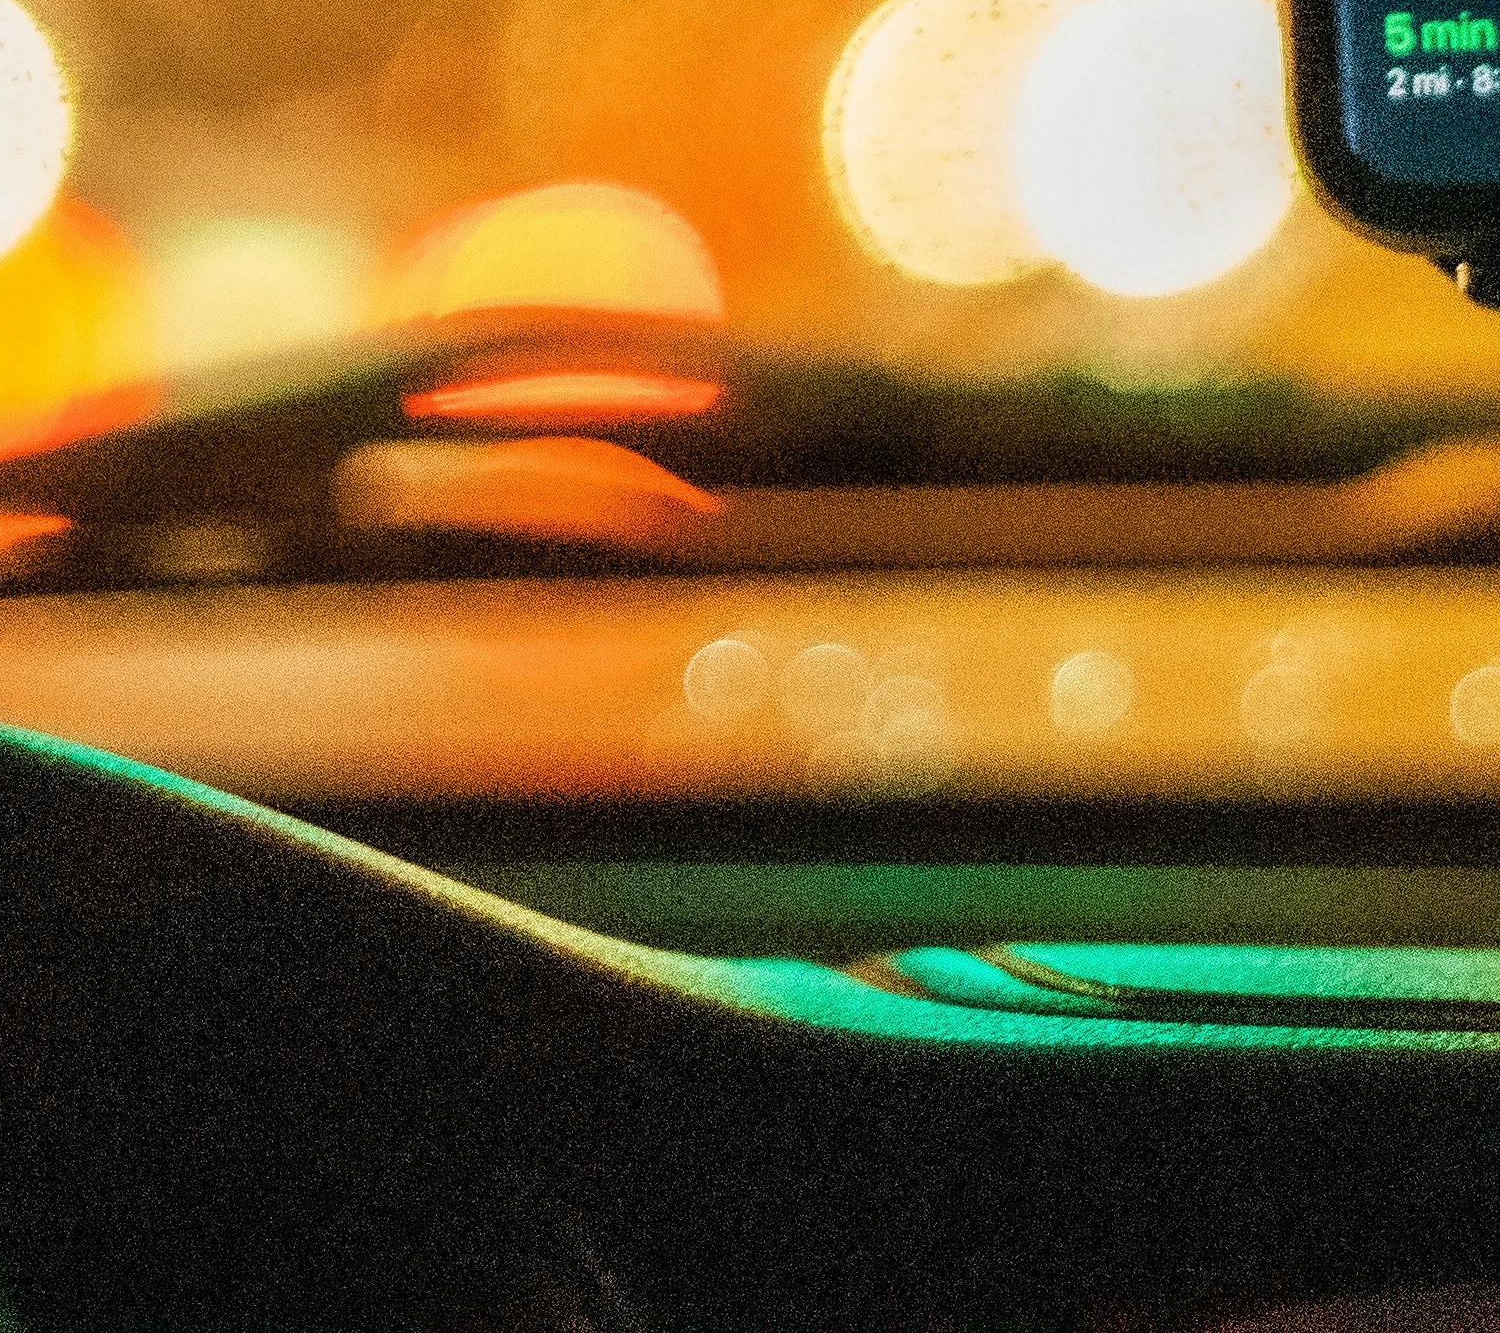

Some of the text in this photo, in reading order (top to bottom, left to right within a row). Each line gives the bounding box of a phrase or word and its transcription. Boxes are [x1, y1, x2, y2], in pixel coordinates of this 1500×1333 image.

[1384, 10, 1498, 56] 5 min
[1386, 66, 1408, 98] 2
[1412, 63, 1450, 96] mi
